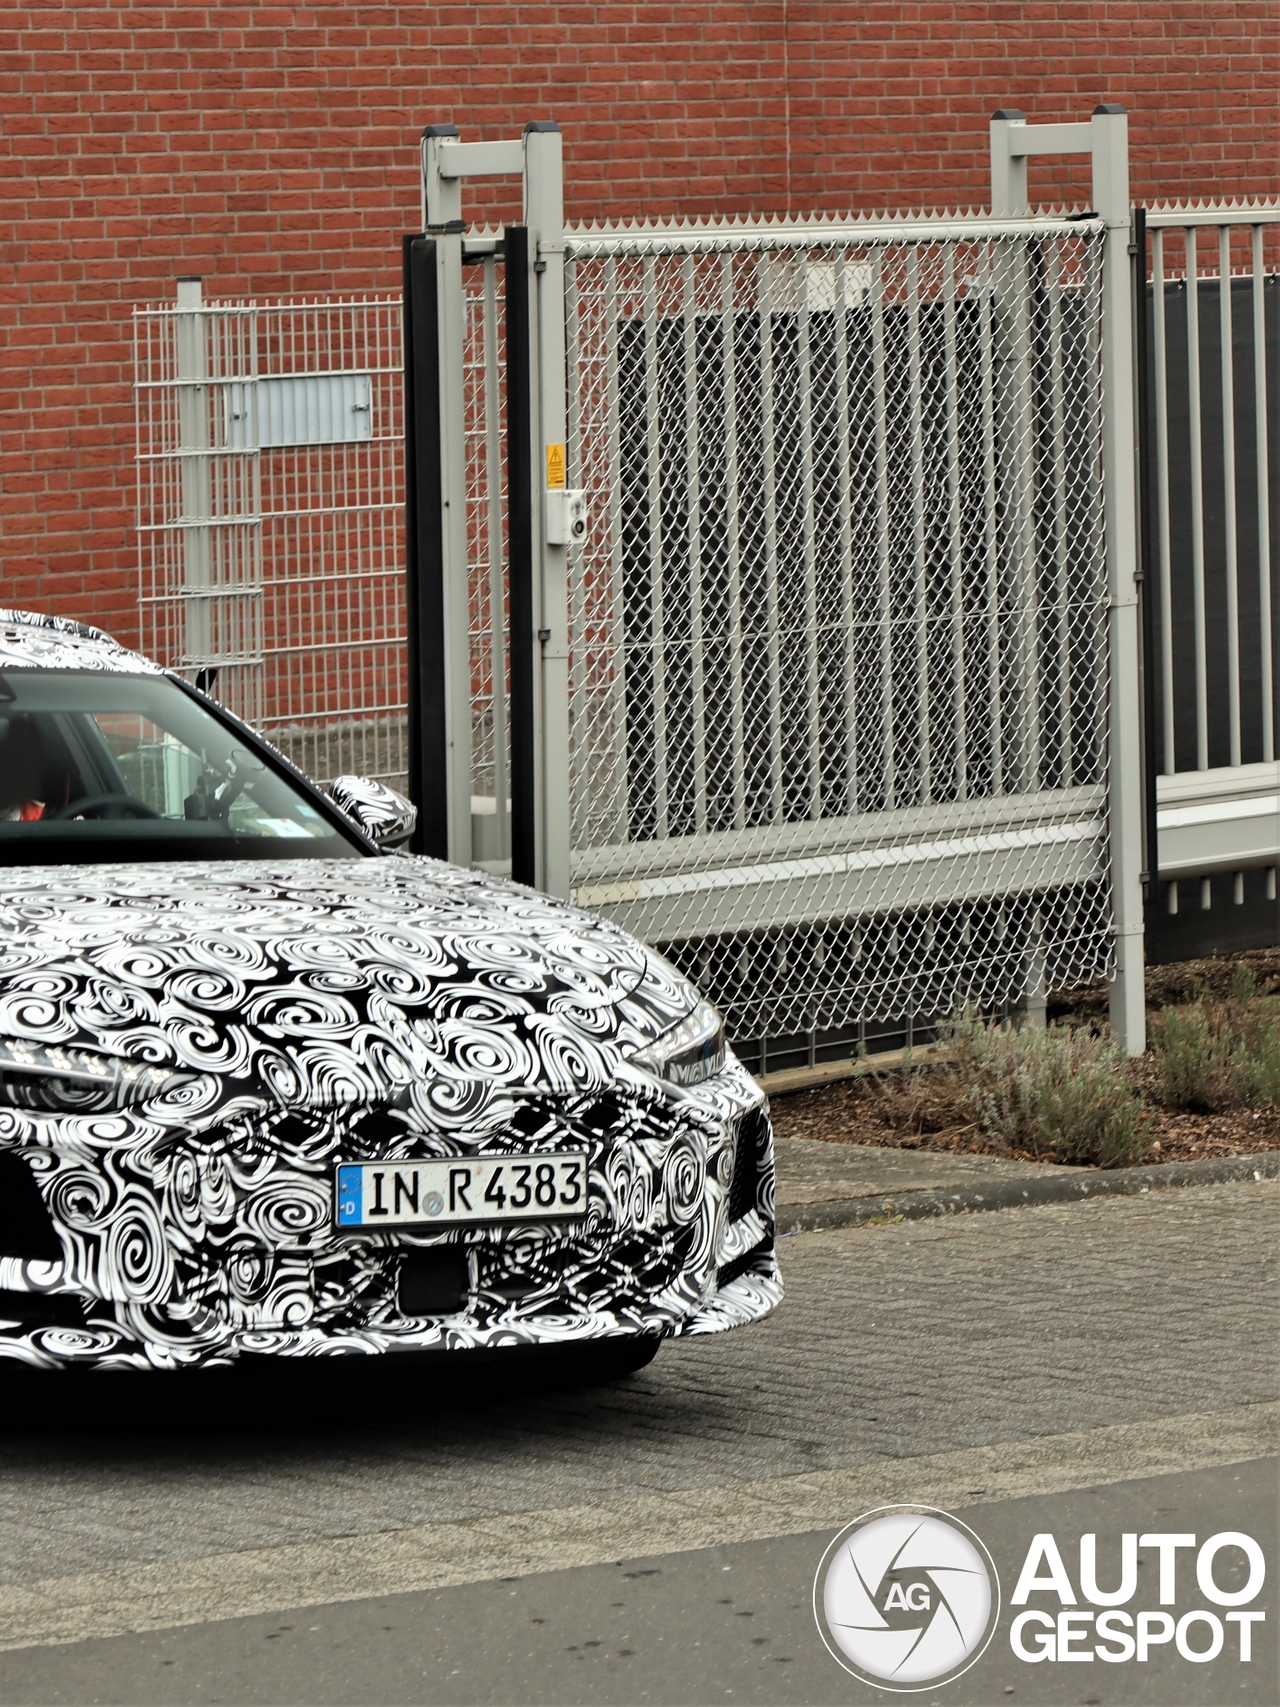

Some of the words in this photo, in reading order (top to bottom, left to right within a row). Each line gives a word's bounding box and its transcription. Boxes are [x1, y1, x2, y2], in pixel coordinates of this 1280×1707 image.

[345, 1201, 356, 1215] D
[368, 1170, 419, 1216] IN
[449, 1168, 473, 1212] R
[484, 1162, 582, 1210] 4383
